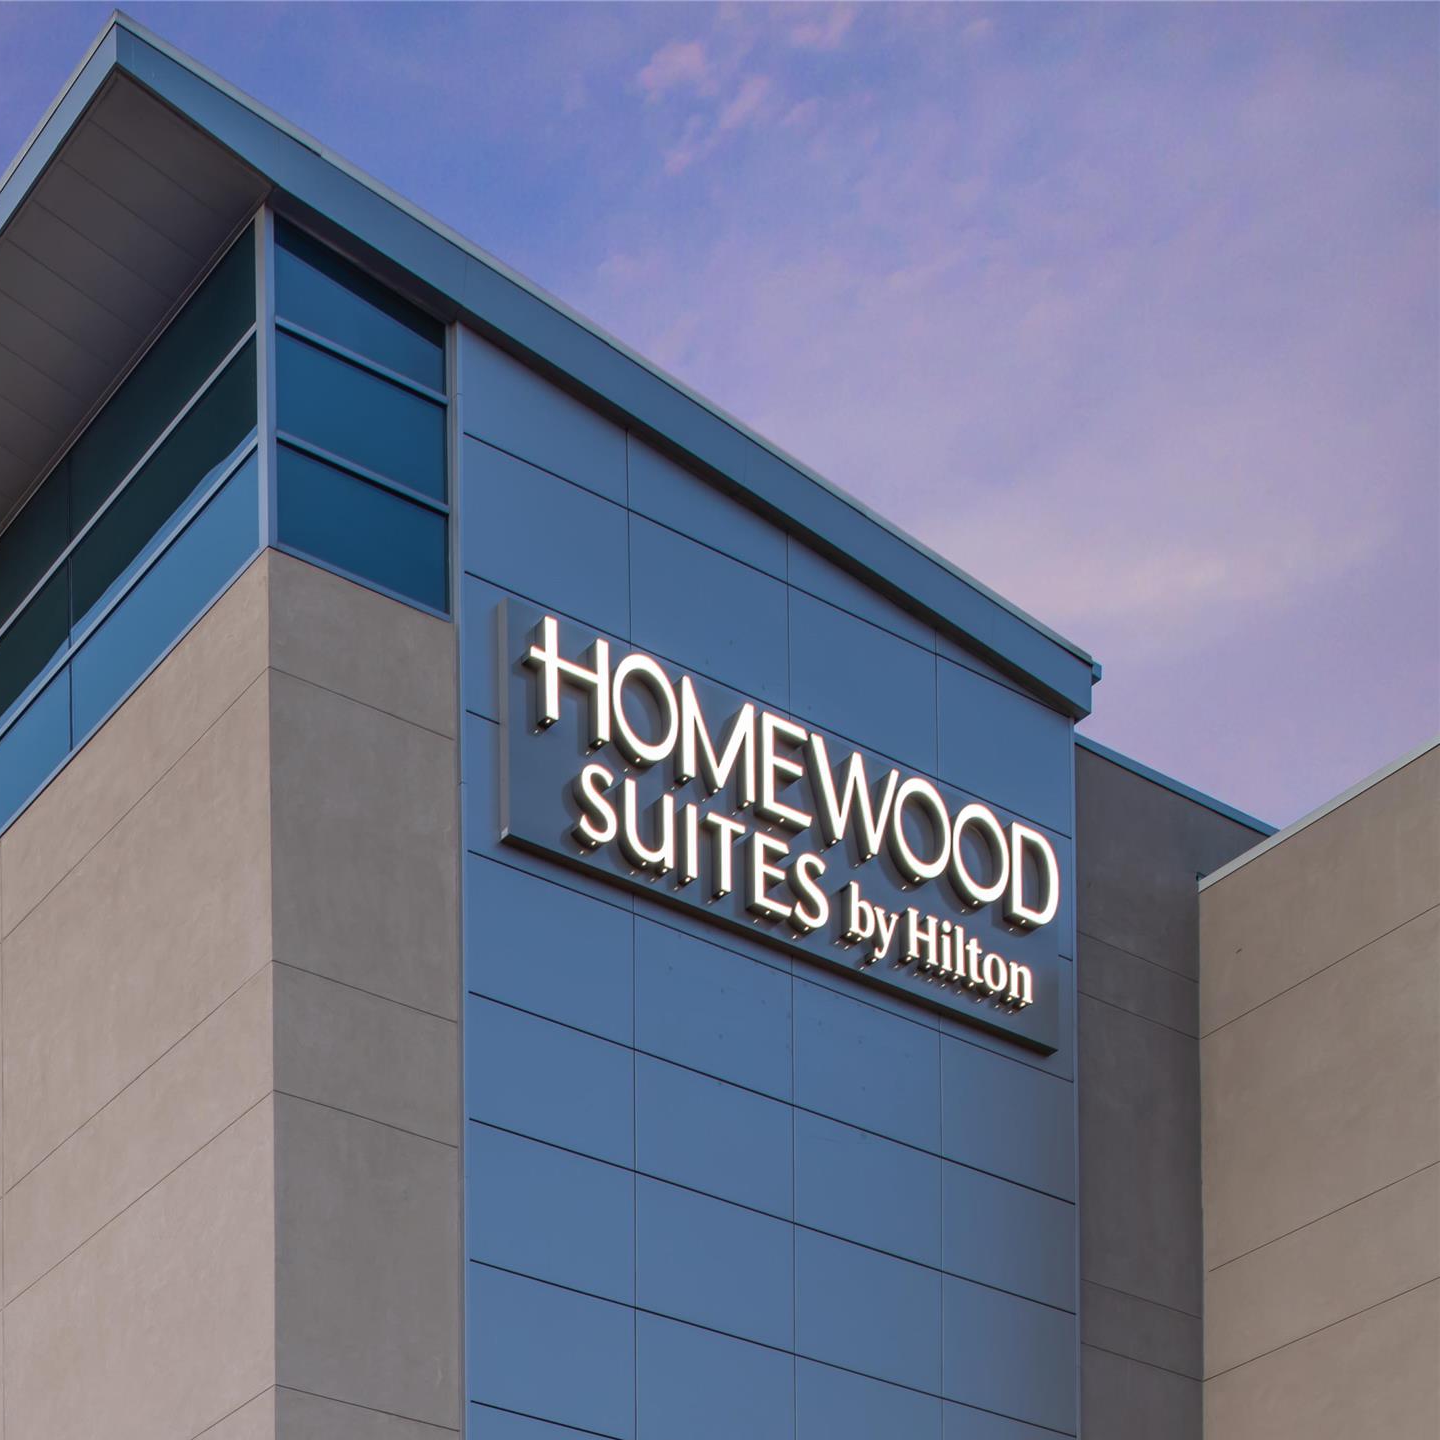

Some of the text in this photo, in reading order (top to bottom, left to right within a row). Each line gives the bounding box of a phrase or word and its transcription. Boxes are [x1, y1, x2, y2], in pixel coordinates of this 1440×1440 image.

[530, 616, 1059, 926] HOMEWOOD
[578, 763, 1034, 1005] SUITES by Hilton
